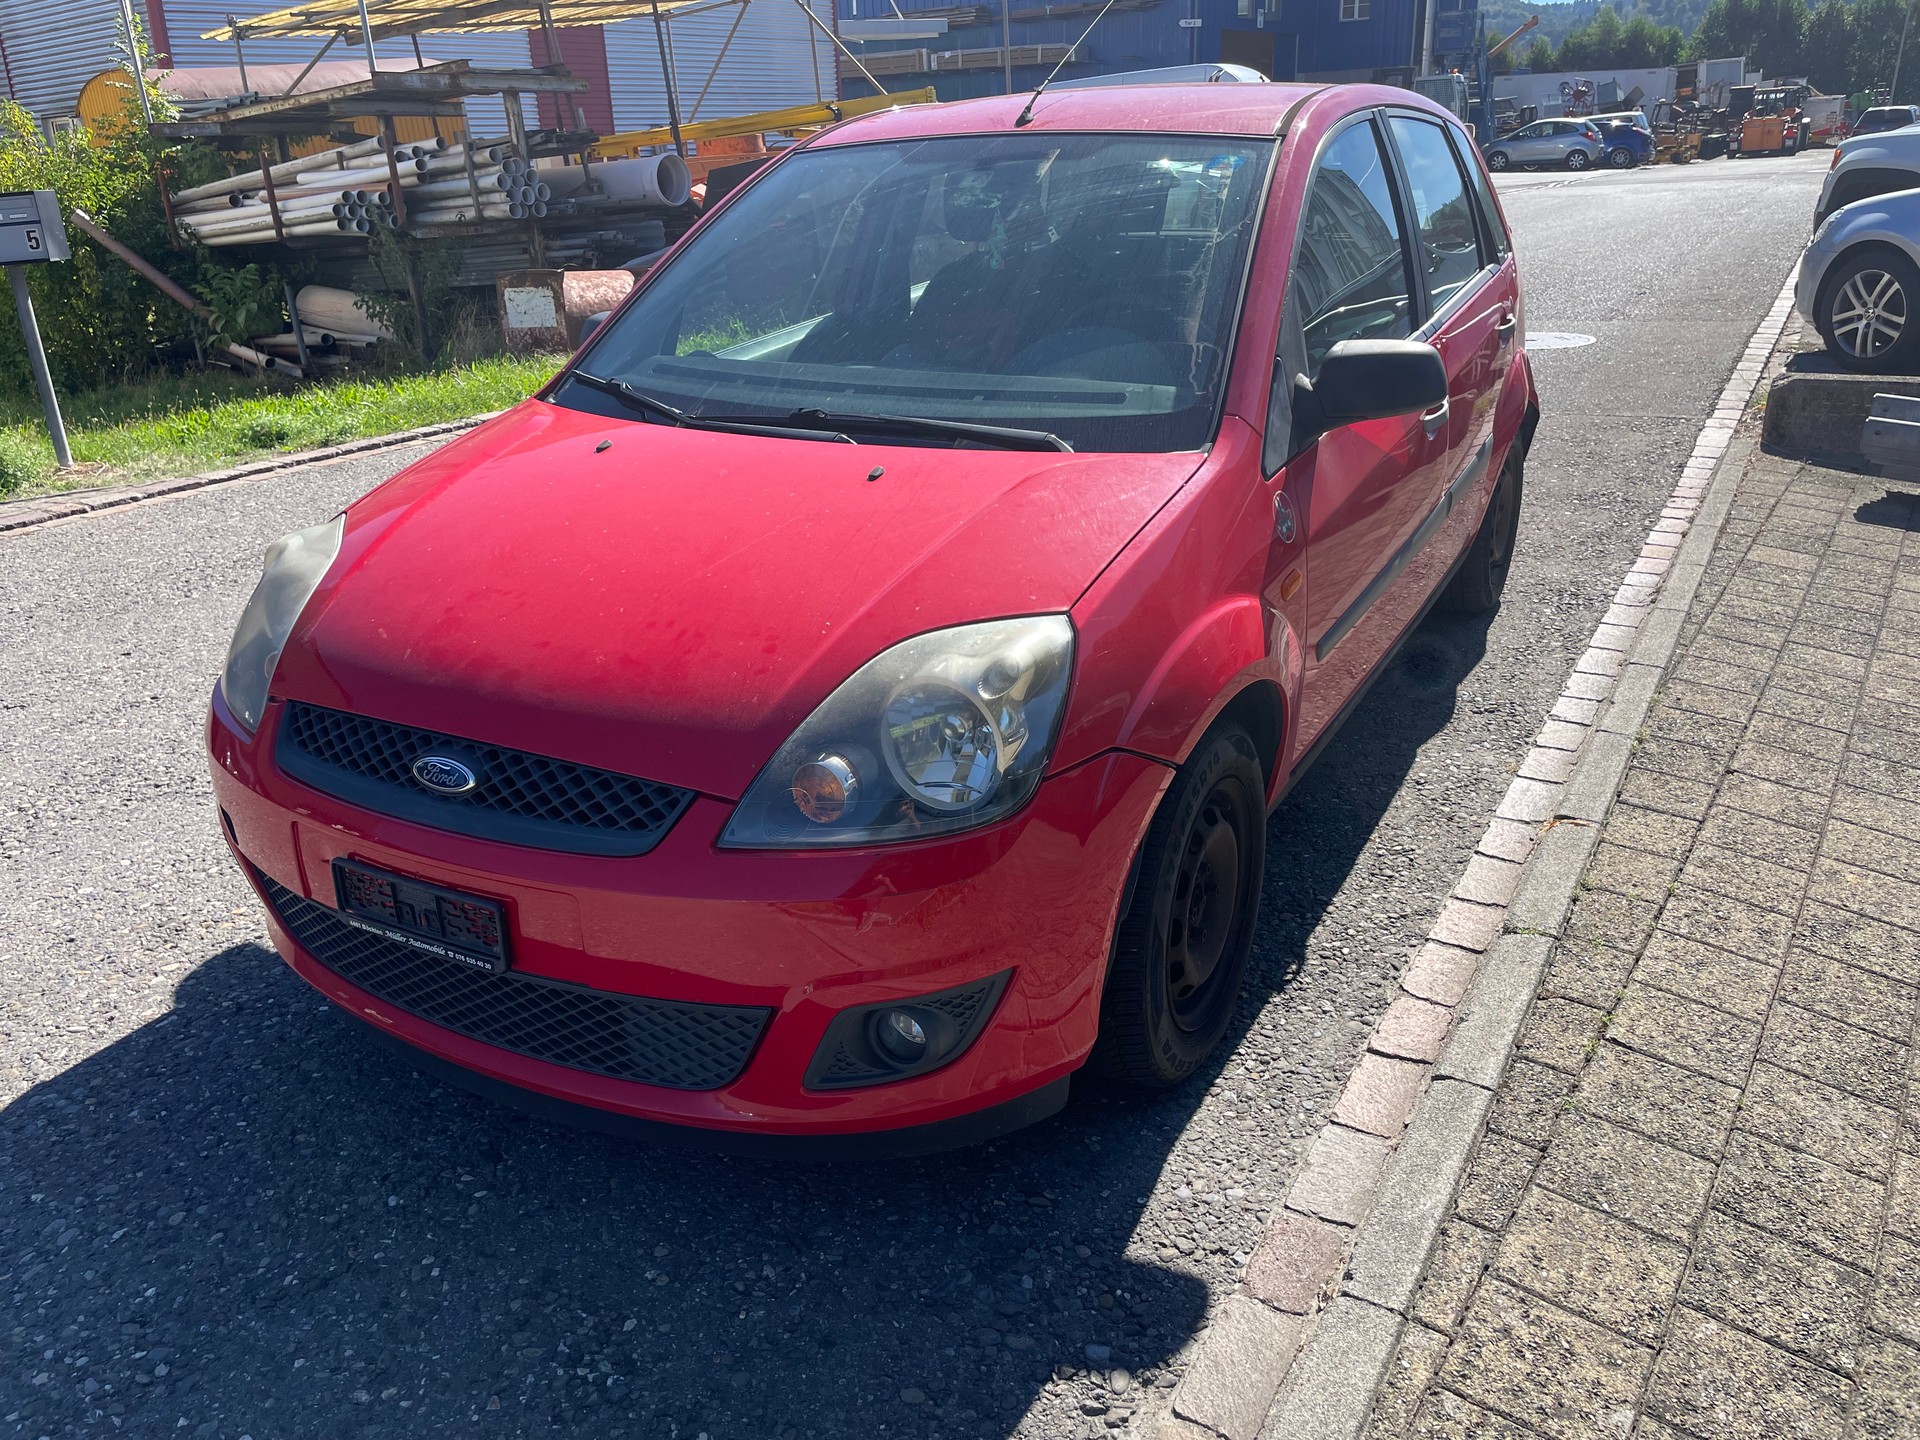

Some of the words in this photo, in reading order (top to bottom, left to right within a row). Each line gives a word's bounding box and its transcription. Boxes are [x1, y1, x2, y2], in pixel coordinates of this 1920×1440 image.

[25, 230, 40, 250] 5
[423, 762, 459, 786] Ford
[384, 930, 406, 943] Müller
[408, 938, 446, 955] Automobile
